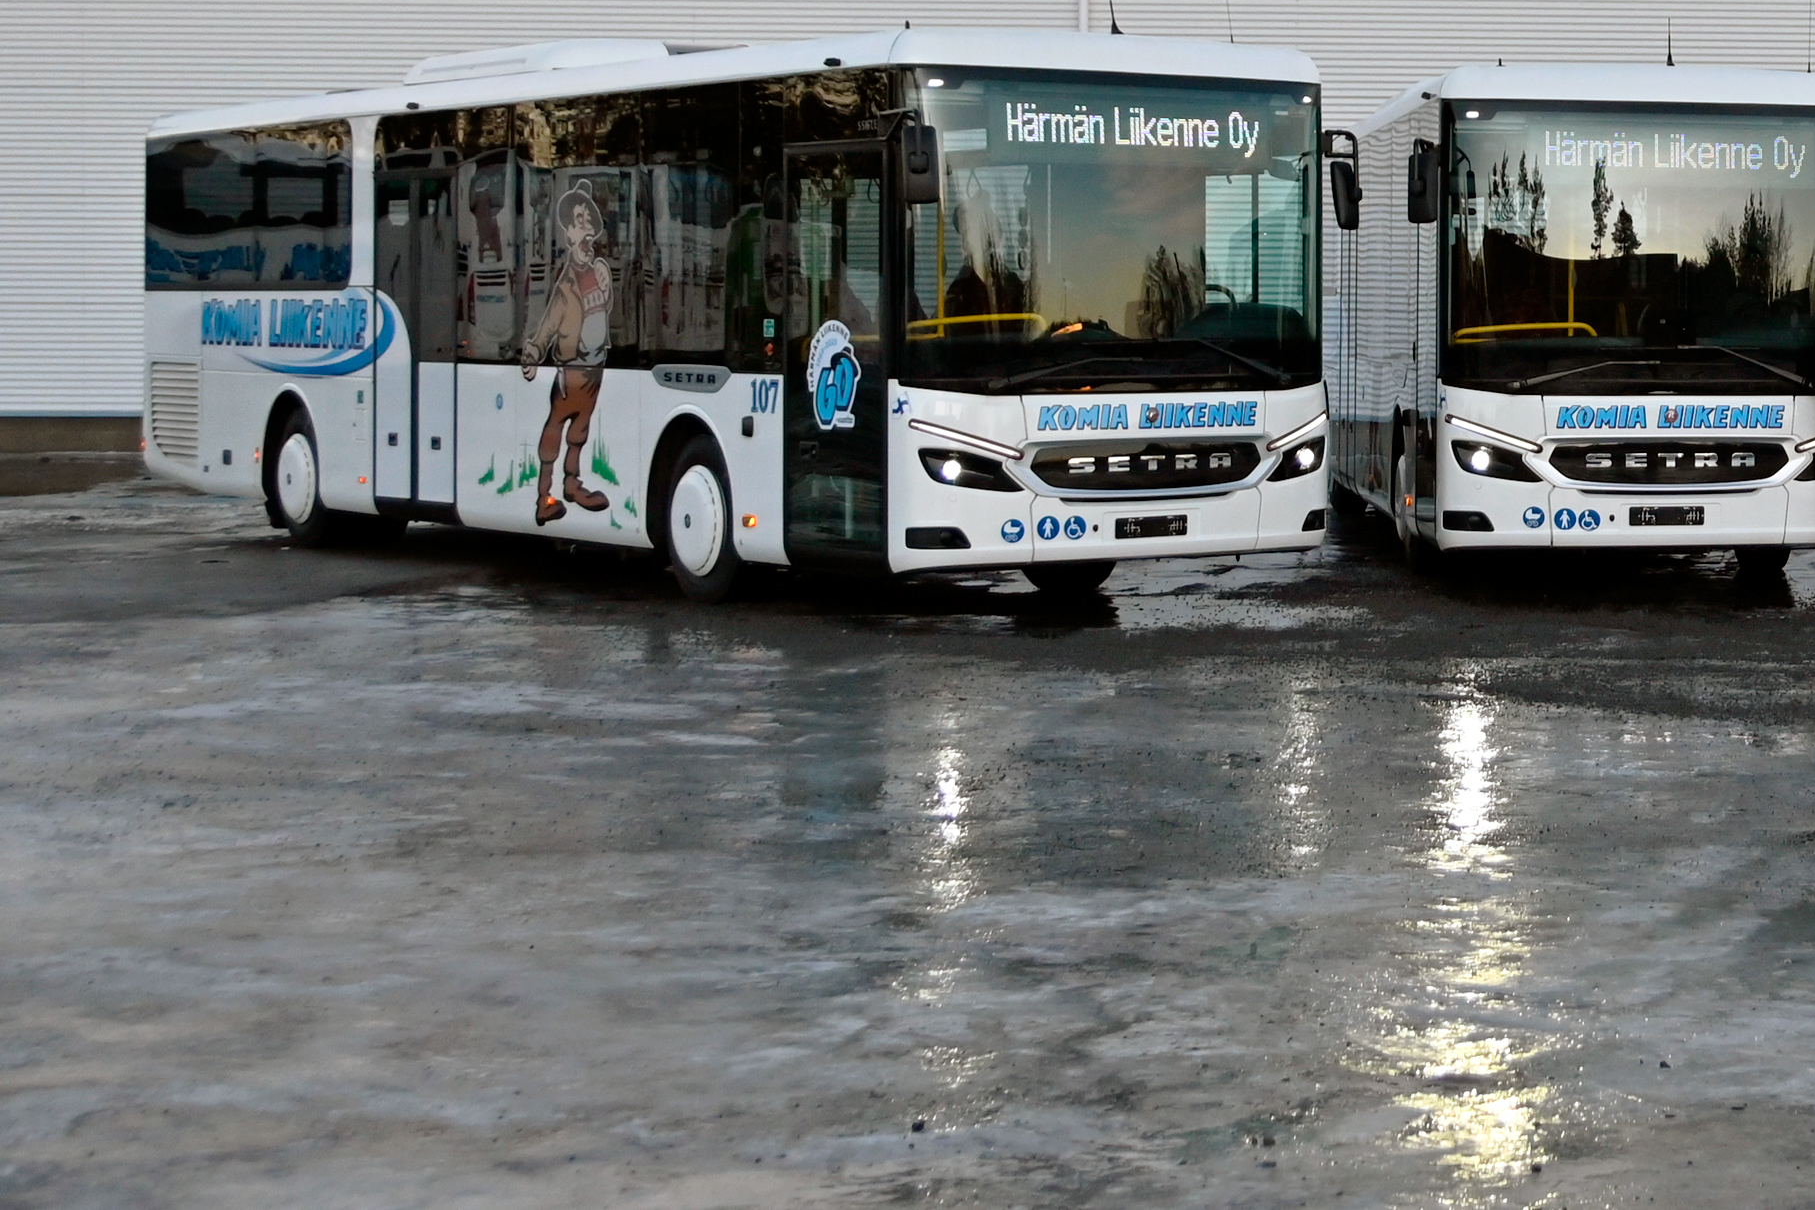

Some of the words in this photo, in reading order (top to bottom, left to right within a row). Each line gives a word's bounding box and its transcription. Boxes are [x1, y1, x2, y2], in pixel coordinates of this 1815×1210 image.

[1006, 102, 1105, 144] Härmän
[1114, 106, 1220, 148] Liikenne
[1228, 111, 1259, 158] Oy
[1545, 130, 1643, 168] Härmän
[1654, 133, 1763, 169] Liikenne
[1773, 136, 1806, 178] Oy
[202, 298, 262, 347] KOMIA
[269, 298, 367, 349] LIIKENNE
[664, 372, 716, 384] SETRA
[816, 355, 856, 426] 60
[750, 378, 779, 414] 107
[1037, 404, 1129, 430] KOMIA
[1138, 401, 1257, 429] LIIKENNE
[1556, 404, 1647, 429] KOMIA
[1657, 404, 1785, 429] LIIKENNE
[1068, 452, 1232, 474] SETRA
[1585, 452, 1755, 468] SETRA
